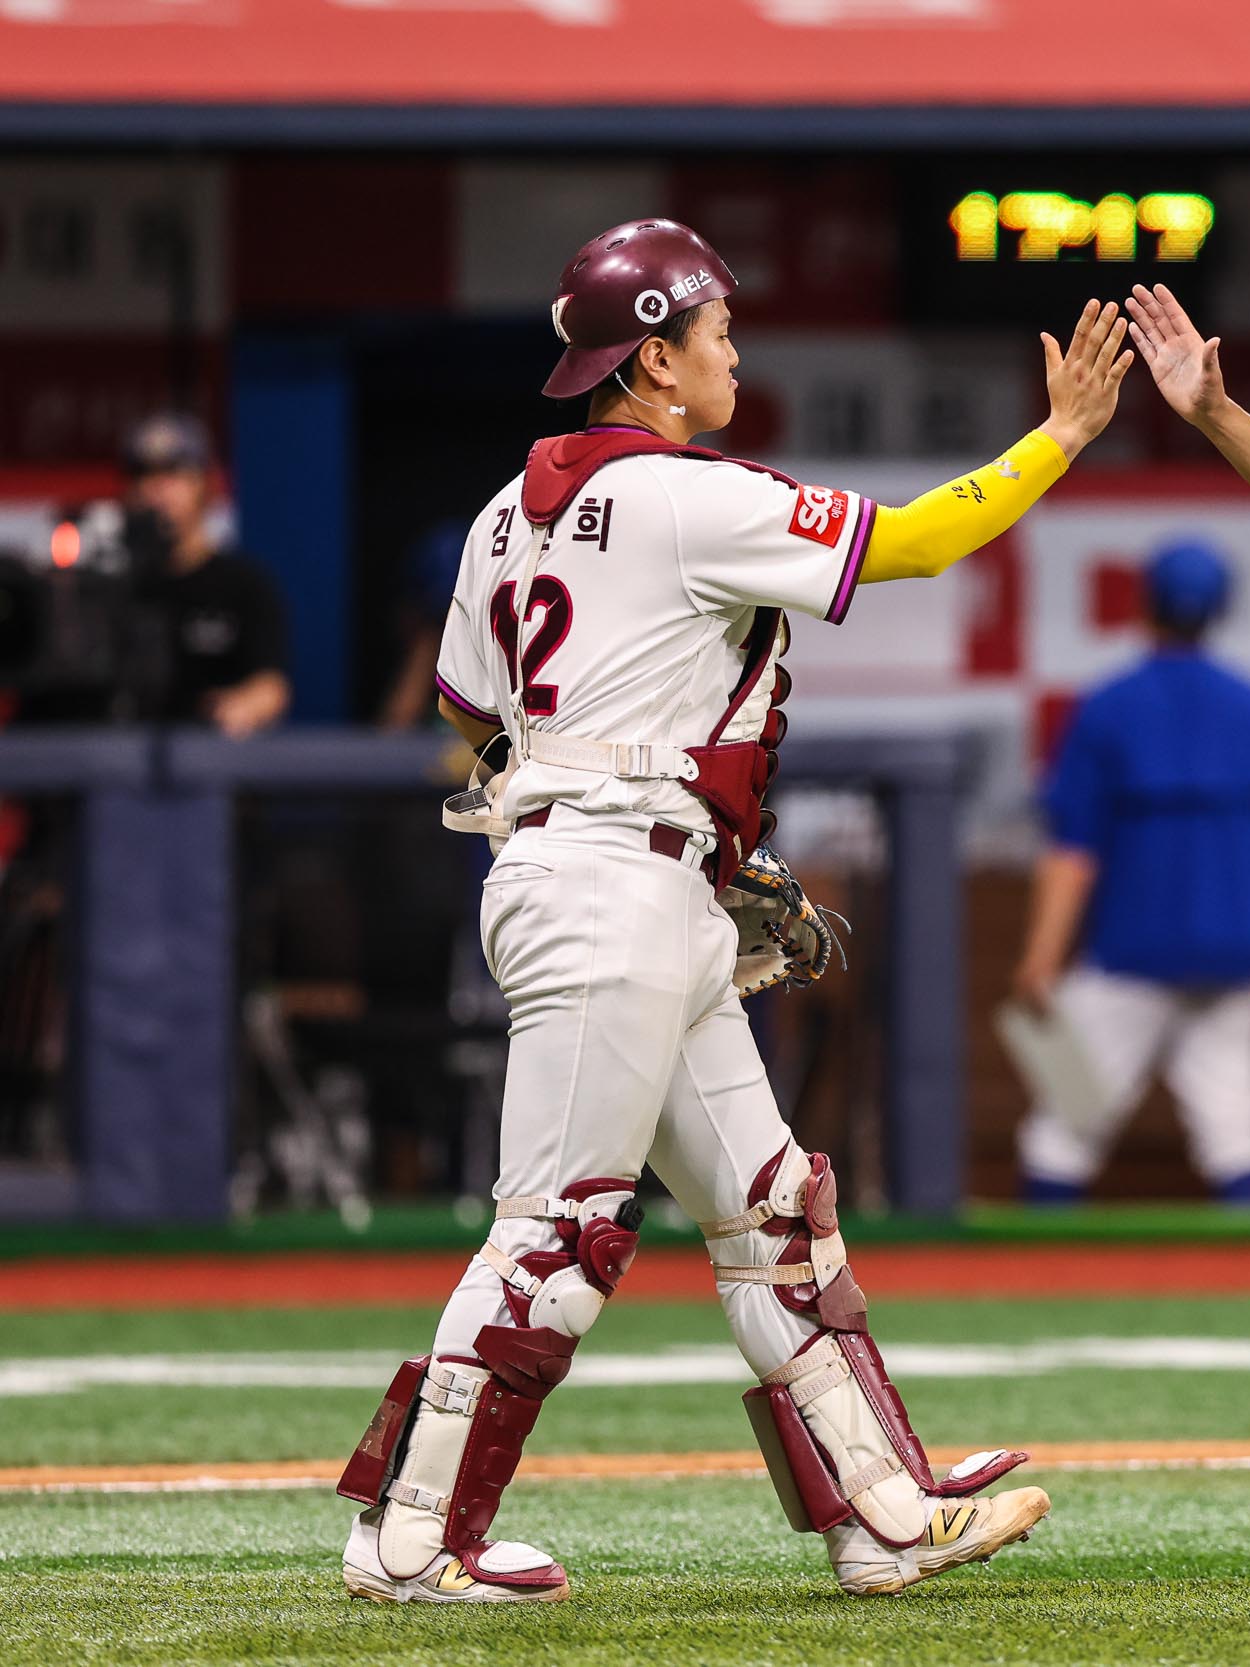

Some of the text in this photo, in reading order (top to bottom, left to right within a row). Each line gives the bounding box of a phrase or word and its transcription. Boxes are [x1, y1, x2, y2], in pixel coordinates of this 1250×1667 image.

[669, 269, 713, 302] 메티스
[491, 498, 613, 557] 김희
[490, 574, 573, 716] 12
